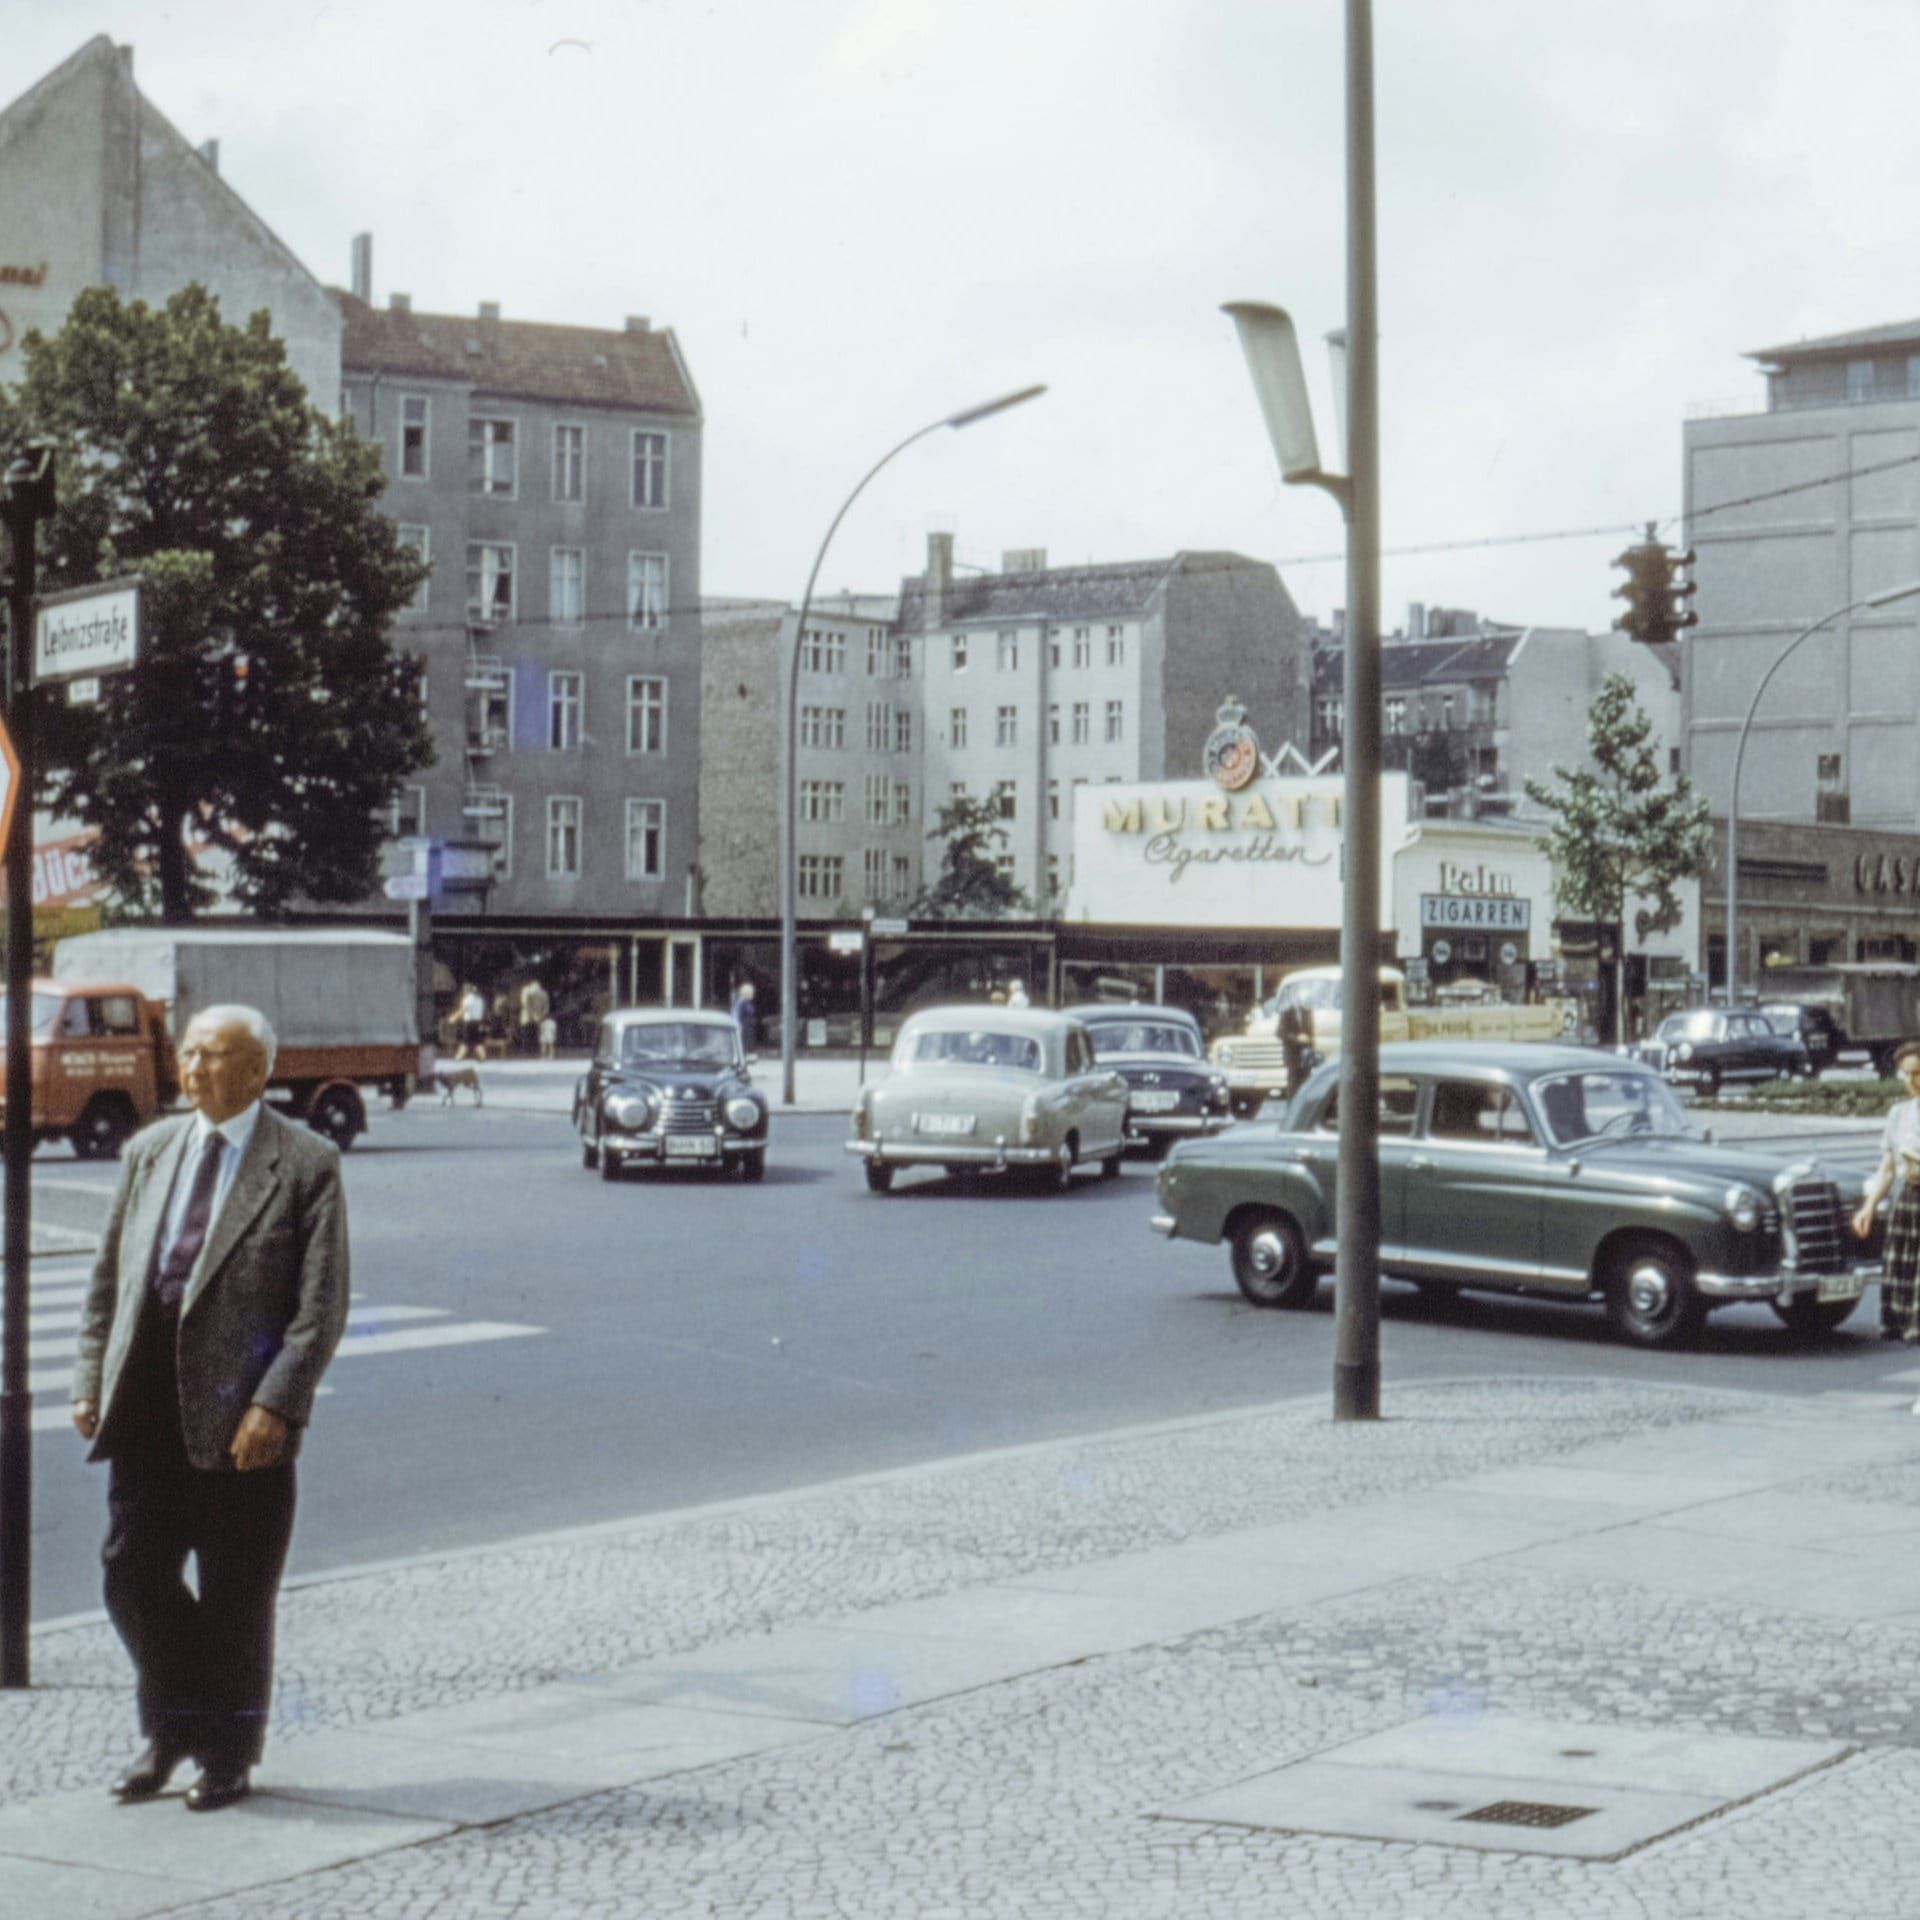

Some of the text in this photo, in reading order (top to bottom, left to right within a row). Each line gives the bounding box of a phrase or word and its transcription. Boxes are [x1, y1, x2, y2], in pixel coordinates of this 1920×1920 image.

[1101, 793, 1347, 835] MURATT
[1144, 831, 1333, 883] Cigaretten
[1427, 900, 1525, 926] ZIGARREN
